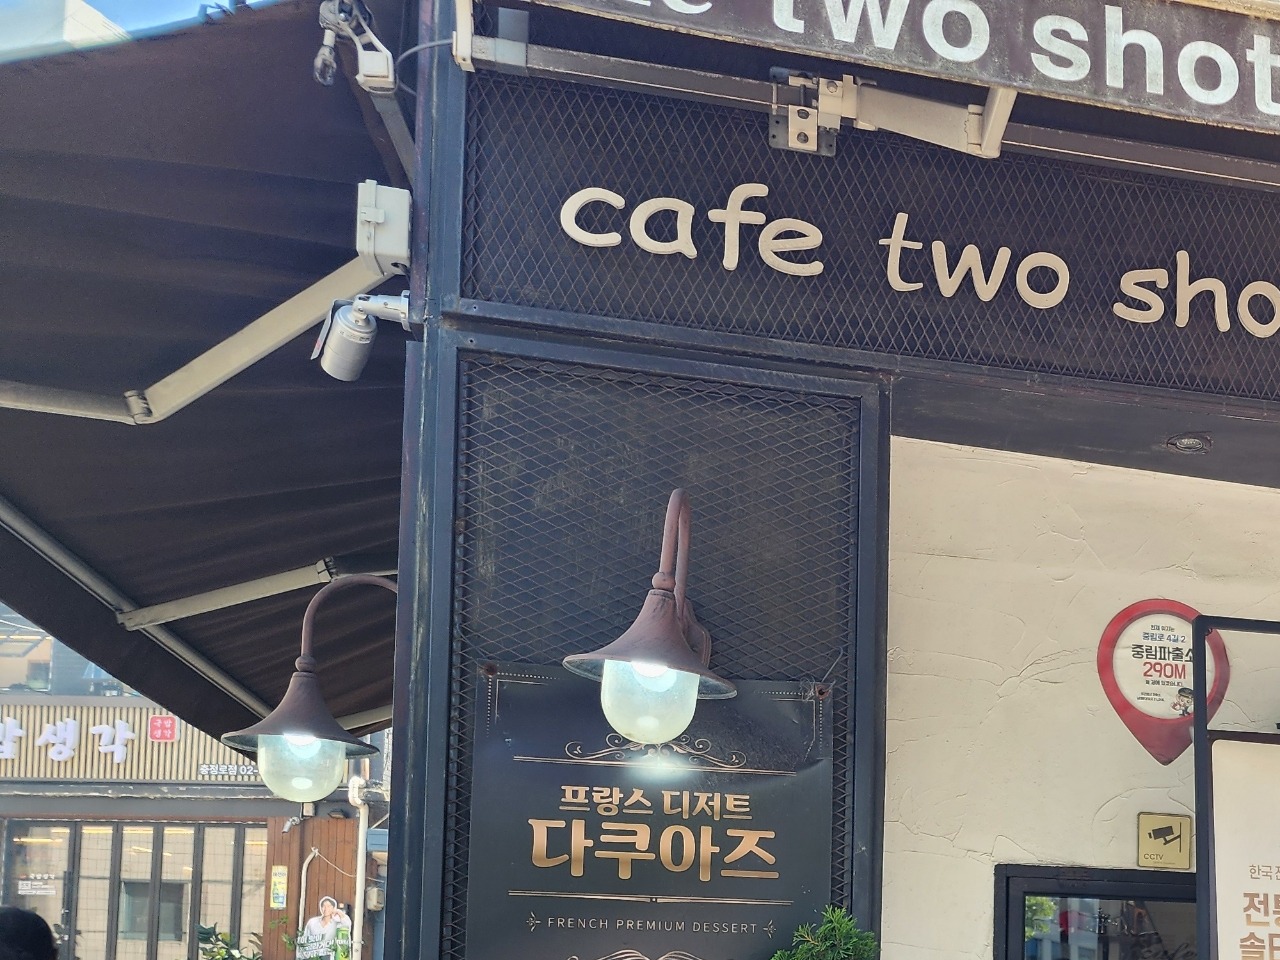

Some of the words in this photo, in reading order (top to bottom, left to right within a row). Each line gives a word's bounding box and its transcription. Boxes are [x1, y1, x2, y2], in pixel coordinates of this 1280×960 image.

[559, 183, 825, 277] cafe
[878, 212, 1070, 310] two
[1143, 632, 1165, 642] 중림로
[1143, 661, 1186, 680] 290M
[200, 764, 237, 775] 충정로점
[559, 785, 653, 817] 프랑스
[662, 789, 752, 821] 디저트
[528, 818, 780, 882] 다쿠아즈
[1249, 864, 1273, 881] 한국
[548, 917, 609, 931] FRENCH
[616, 919, 686, 932] PREMIUM
[692, 921, 758, 934] DESSERT
